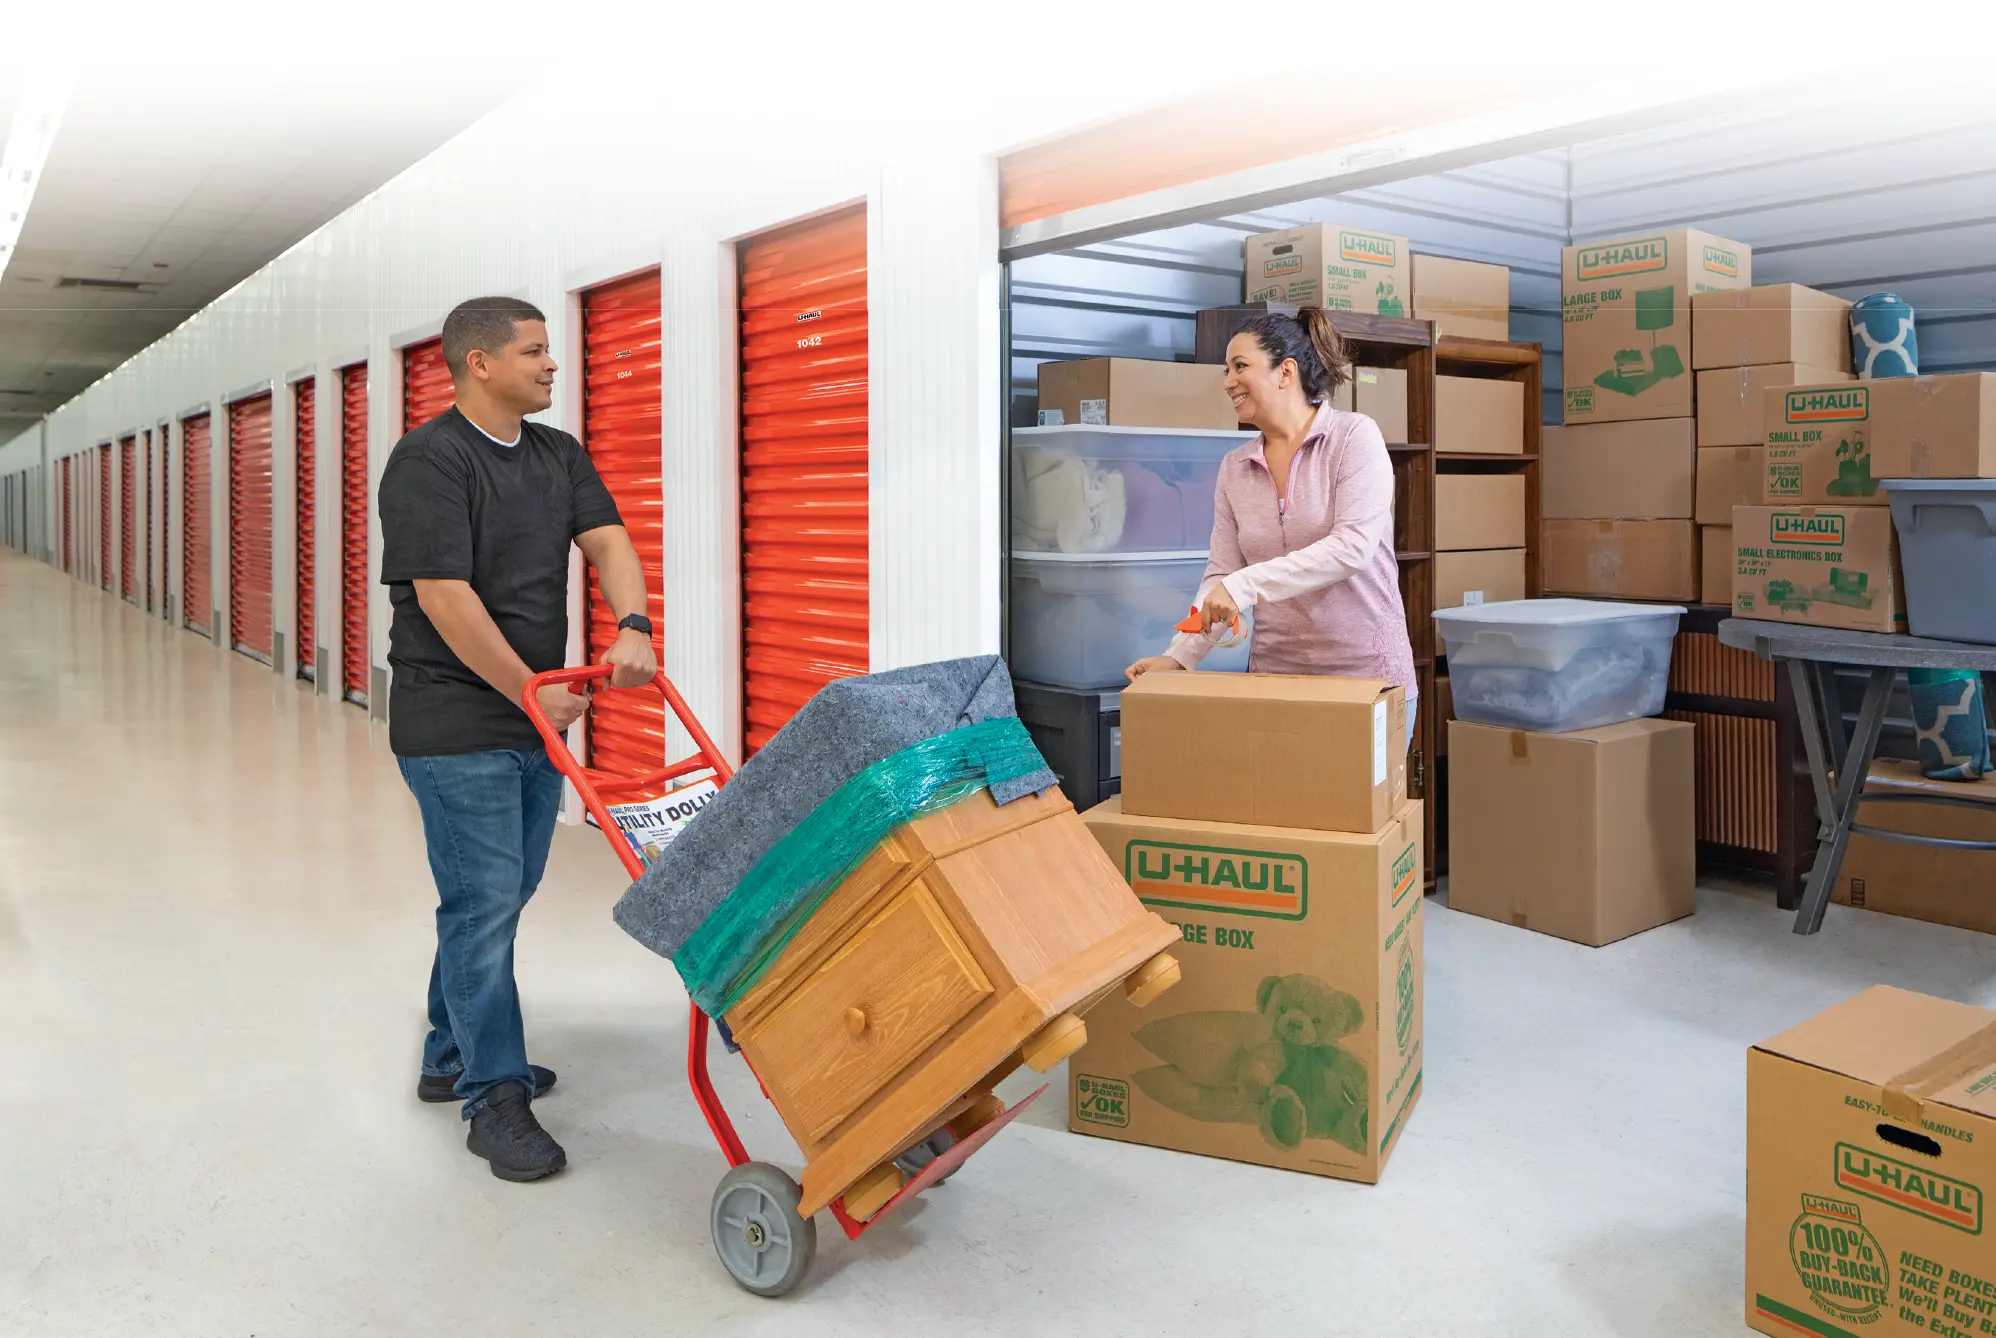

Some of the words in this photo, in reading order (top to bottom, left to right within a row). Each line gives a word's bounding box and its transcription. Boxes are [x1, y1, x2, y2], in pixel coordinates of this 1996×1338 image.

[1344, 235, 1392, 256] U-HAUL
[1583, 243, 1662, 268] U-HAUL
[1266, 258, 1300, 271] U-HAUL
[1705, 249, 1736, 269] U-HAUL
[1328, 265, 1351, 278] SMALL
[1353, 268, 1367, 280] BOX
[1563, 292, 1597, 307] LARGE
[1600, 288, 1622, 302] BOX
[798, 311, 821, 321] U-HAUL
[797, 336, 822, 348] 1042
[1791, 391, 1863, 412] U-HAUL
[1768, 431, 1800, 443] SMALL
[1802, 430, 1822, 442] BOX
[1780, 477, 1799, 489] OK
[1776, 518, 1840, 534] U-HAUL
[1737, 547, 1764, 558] SMALL
[1766, 549, 1822, 561] ELECTRONICS
[1825, 552, 1843, 562] BOX
[1139, 851, 1295, 894] U-HAUL
[1215, 927, 1255, 950] BOX
[1092, 1081, 1125, 1092] U-HAUL
[1092, 1088, 1125, 1099] BOXES
[1095, 1097, 1125, 1115] OK
[1094, 1112, 1125, 1123] SHIPPING
[1921, 1119, 1974, 1143] HANDLES
[1844, 1151, 1972, 1213] U-HAUL
[1806, 1197, 1857, 1217] U-HAUL
[1800, 1222, 1873, 1262] 100%
[1800, 1250, 1883, 1285] BUY-BACK
[1900, 1250, 1943, 1278] NEED
[1900, 1268, 1940, 1295] TAKE
[1899, 1285, 1938, 1313] We'll
[1943, 1303, 1975, 1329] Buy
[1899, 1305, 1925, 1326] the
